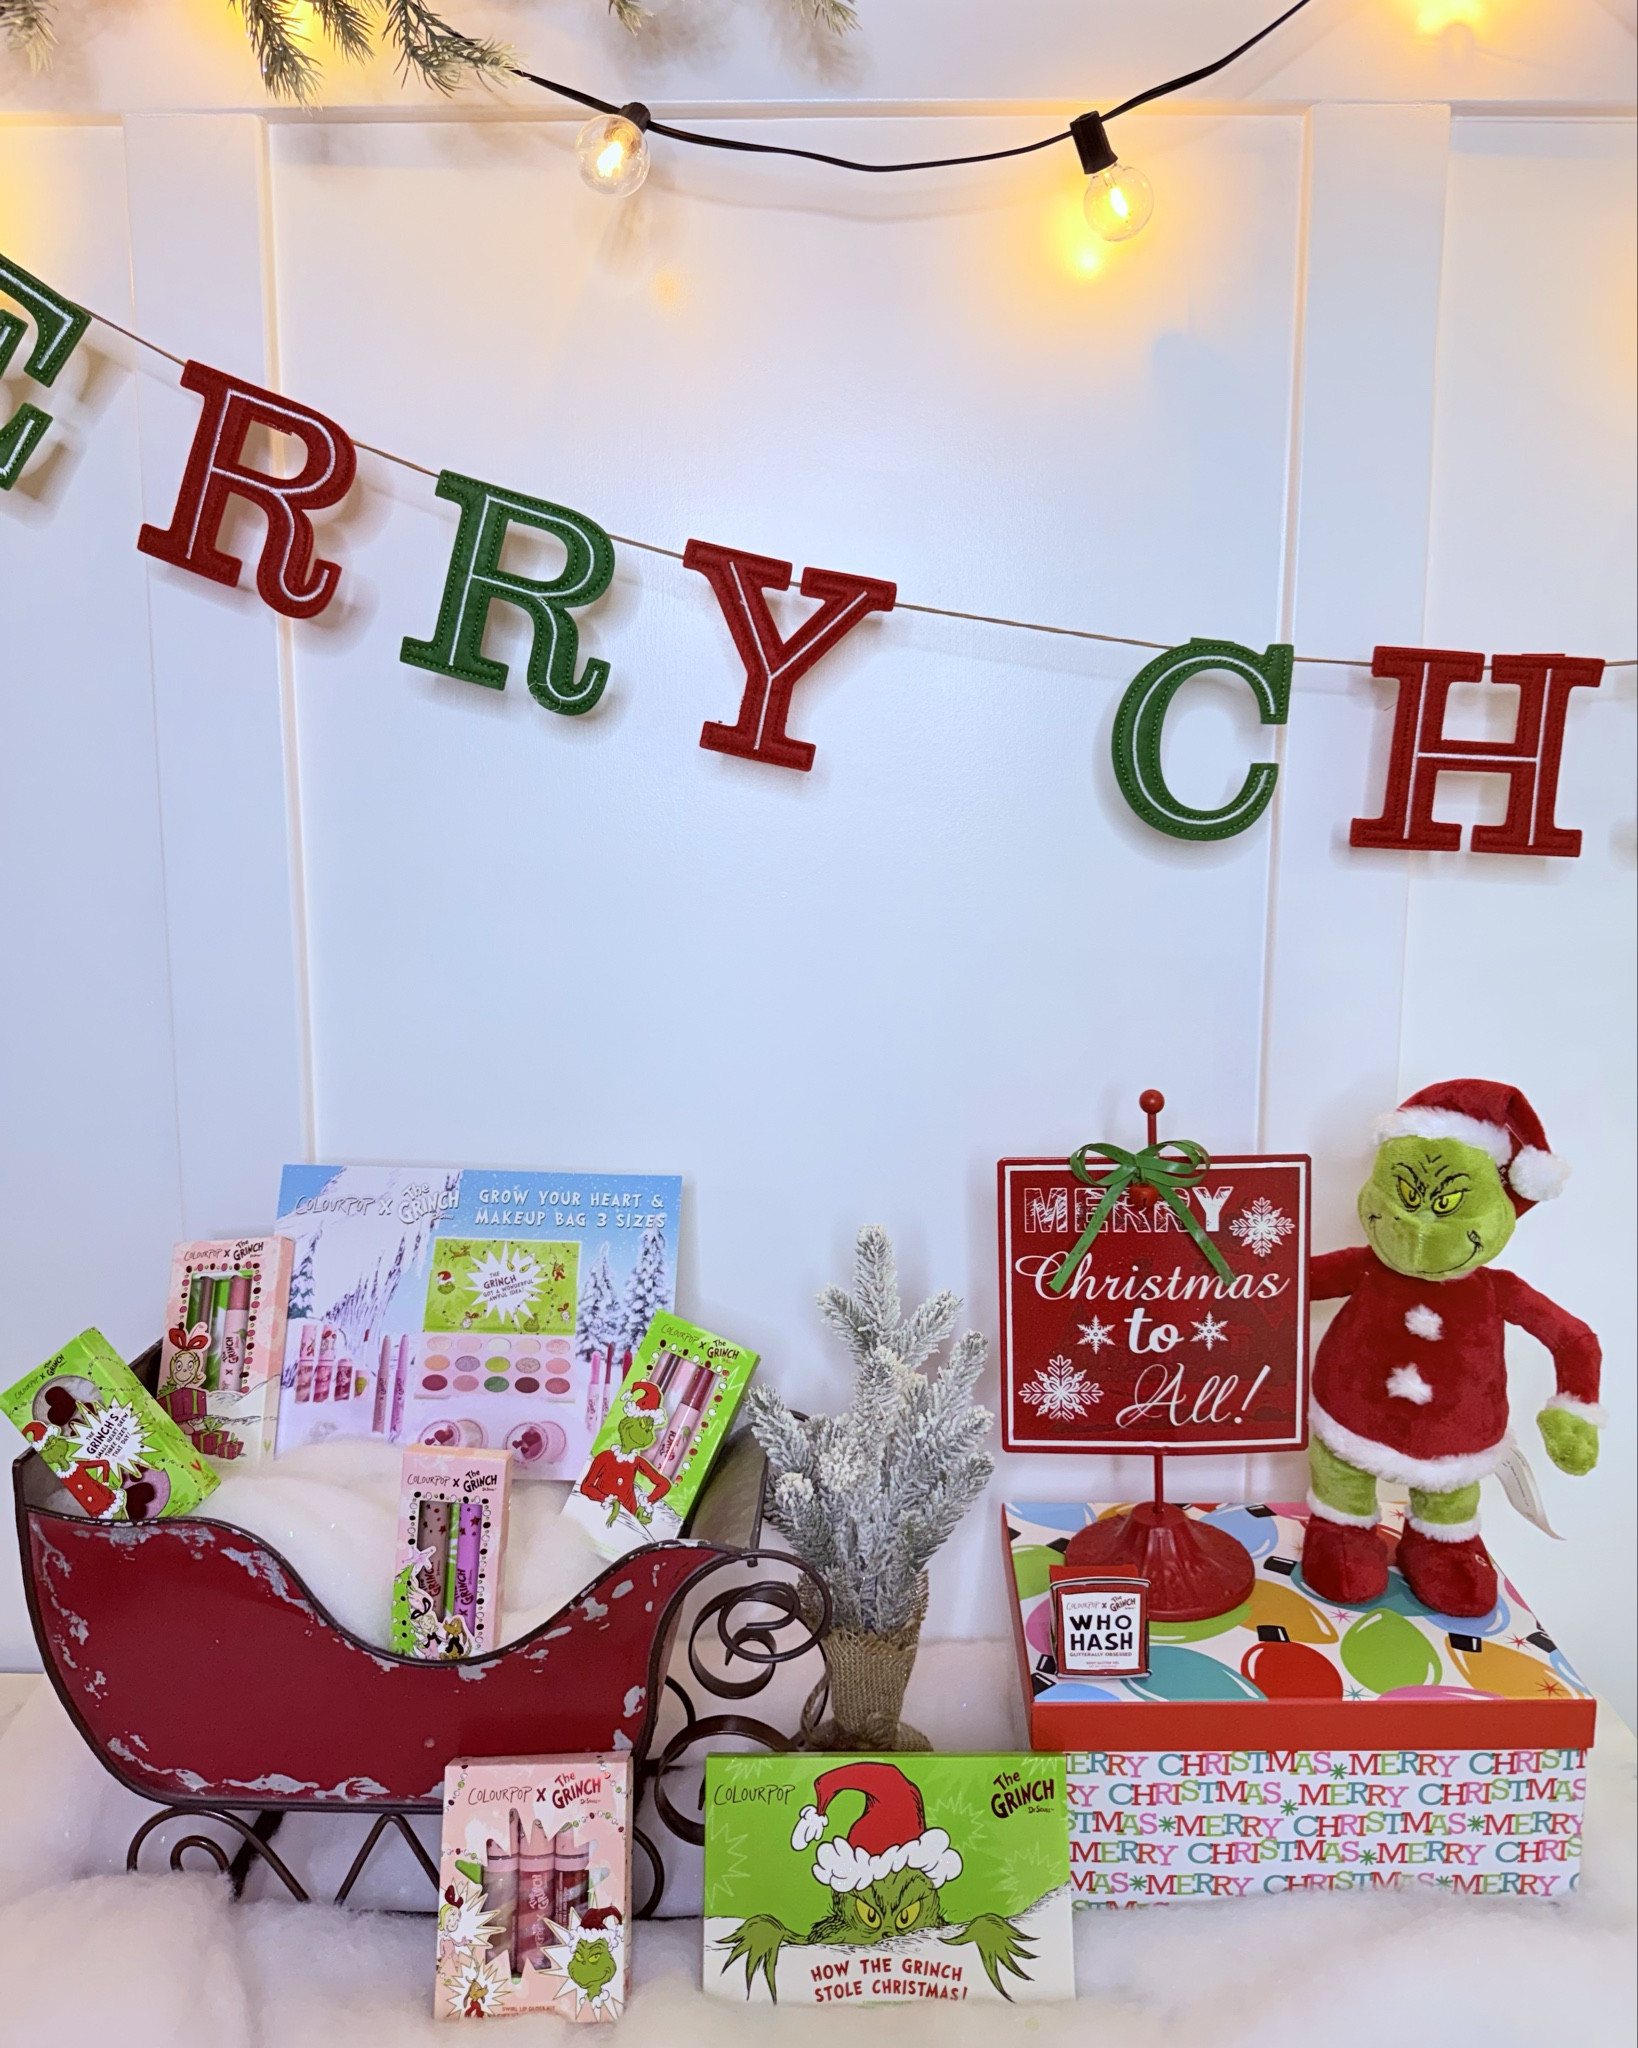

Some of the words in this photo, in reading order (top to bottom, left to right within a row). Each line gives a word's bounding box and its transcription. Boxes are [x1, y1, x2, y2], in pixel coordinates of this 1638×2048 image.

[1112, 637, 1605, 857] CH
[403, 1183, 430, 1200] The
[479, 1188, 529, 1205] GROW
[538, 1190, 580, 1207] YOUR
[590, 1192, 642, 1208] HEART
[651, 1194, 665, 1208] &
[399, 1190, 459, 1224] GRINCH
[474, 1208, 546, 1226] MAKEUP
[555, 1211, 587, 1227] BAG
[596, 1212, 608, 1228] 3
[616, 1213, 666, 1229] SIZES
[233, 1241, 264, 1261] GRINCH
[483, 1274, 517, 1289] GRINCH
[1015, 1250, 1291, 1301] Christmas
[1124, 1308, 1185, 1354] to
[225, 1337, 239, 1364] GRINCH
[707, 1346, 740, 1360] GRINCH
[1116, 1362, 1271, 1428] All!
[86, 1413, 119, 1454] GRINCH'S
[463, 1474, 498, 1493] GRINCH
[457, 1568, 474, 1605] GRINCH
[1110, 1598, 1136, 1611] GRINCH
[1069, 1614, 1132, 1631] WHO
[1070, 1632, 1133, 1651] HASH
[1066, 1751, 1149, 1778] ERRY
[1158, 1750, 1332, 1777] CHRISTMAS
[1350, 1751, 1460, 1778] MERRY
[552, 1776, 601, 1809] GRINCH
[554, 1772, 576, 1787] The
[993, 1772, 1021, 1790] The
[1108, 1780, 1281, 1806] CHRISTMAS
[1298, 1782, 1409, 1808] MERRY
[1418, 1777, 1586, 1806] CHRISTMAS
[714, 1784, 797, 1806] COLOURPOP
[991, 1778, 1054, 1818] GRINCH
[1174, 1814, 1284, 1839] MERRY
[1293, 1811, 1466, 1838] CHRISTMAS
[1483, 1811, 1583, 1836] MERRY
[1069, 1840, 1179, 1866] MERRY
[1188, 1838, 1359, 1864] CHRISTMAS
[1377, 1841, 1486, 1865] MERRY
[532, 1875, 549, 1910] GRINCH
[1146, 1873, 1254, 1898] MERRY
[1263, 1870, 1435, 1894] CHRISTMS
[1451, 1872, 1560, 1897] MERRY
[811, 1961, 850, 1982] HOW
[860, 1958, 893, 1975] THE
[902, 1958, 963, 1981] GRINCH
[814, 1983, 863, 2003] STOLE
[872, 1980, 968, 2000] CHRISTMAS!
